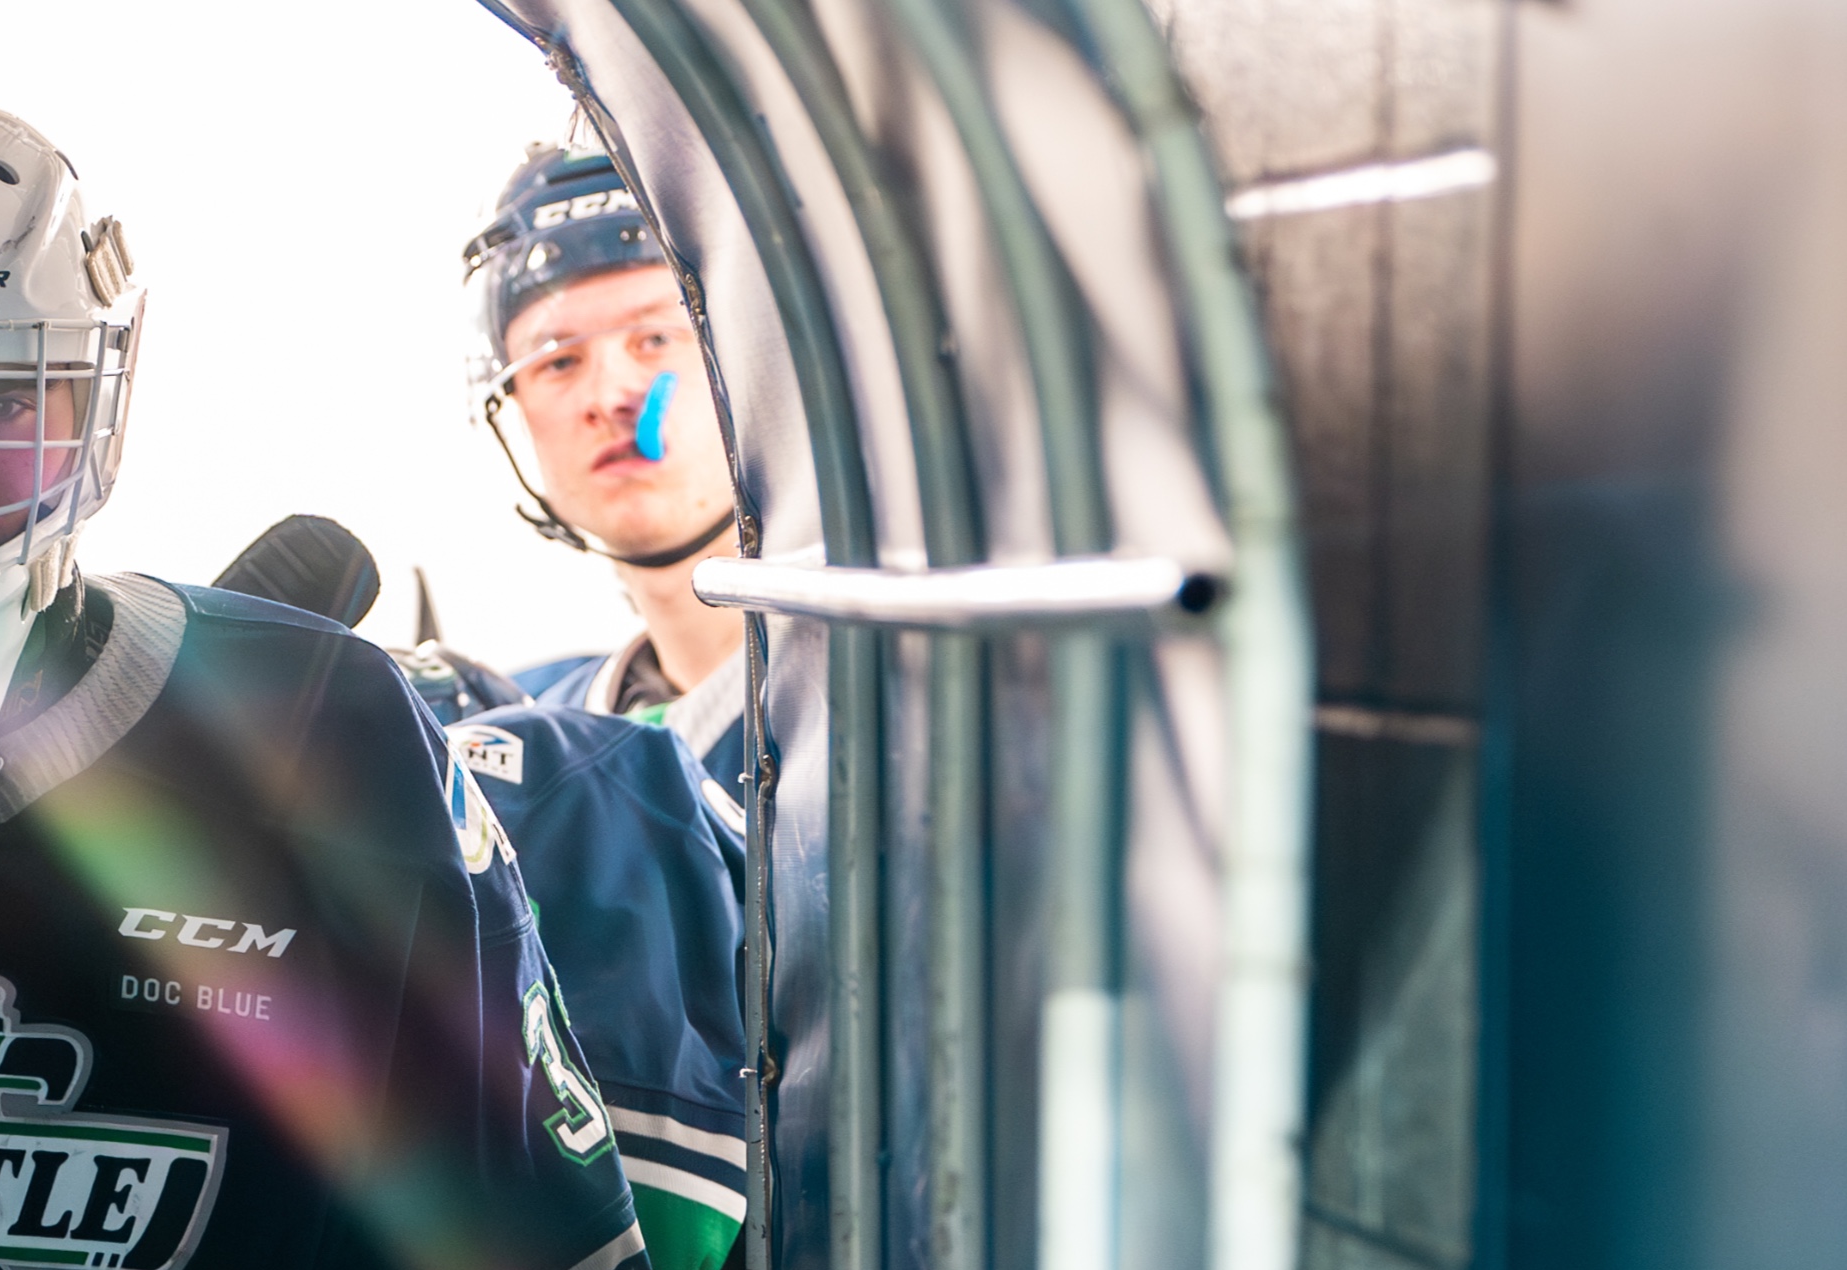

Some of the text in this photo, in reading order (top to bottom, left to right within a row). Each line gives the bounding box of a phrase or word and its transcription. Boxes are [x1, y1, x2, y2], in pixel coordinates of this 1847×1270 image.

[533, 189, 639, 230] CCM
[118, 907, 297, 958] CCM
[121, 974, 272, 1021] DOC BLUE
